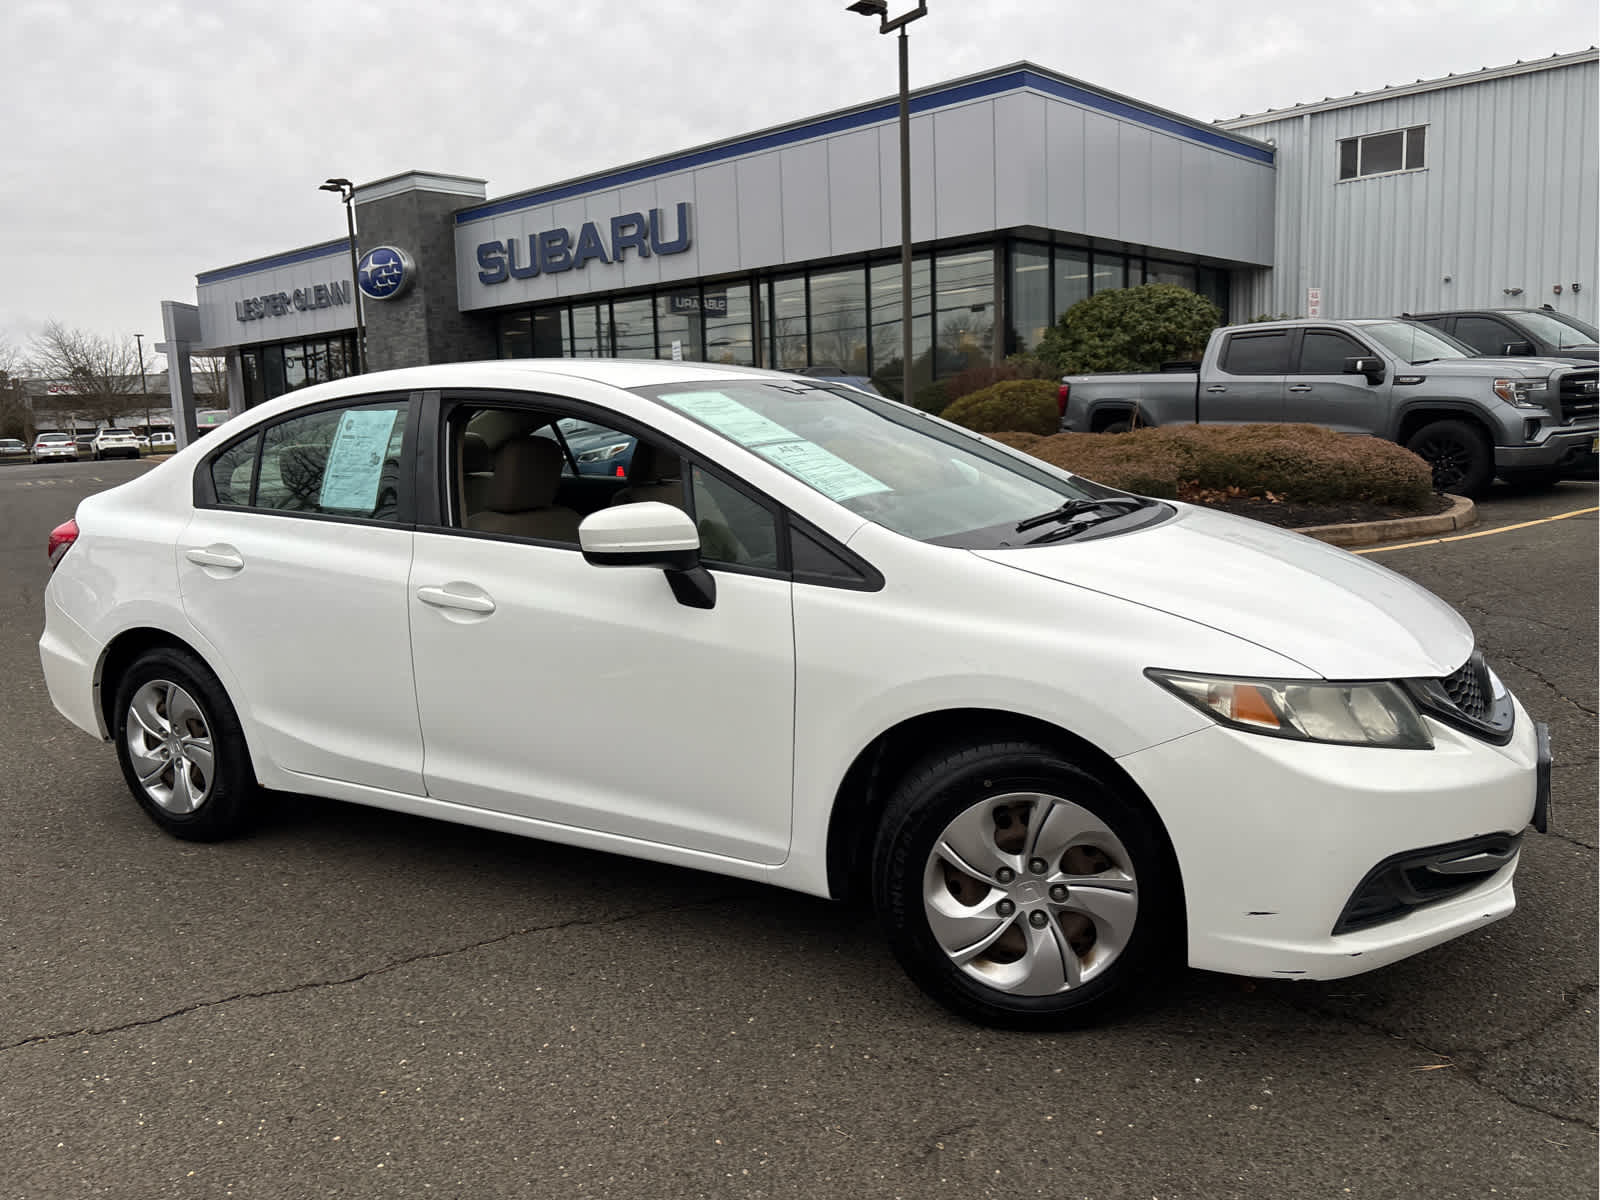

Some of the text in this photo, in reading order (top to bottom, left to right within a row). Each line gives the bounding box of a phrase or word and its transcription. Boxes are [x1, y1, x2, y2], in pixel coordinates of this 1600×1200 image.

[477, 202, 690, 285] SUBARU
[235, 280, 351, 322] LESTER GLENN
